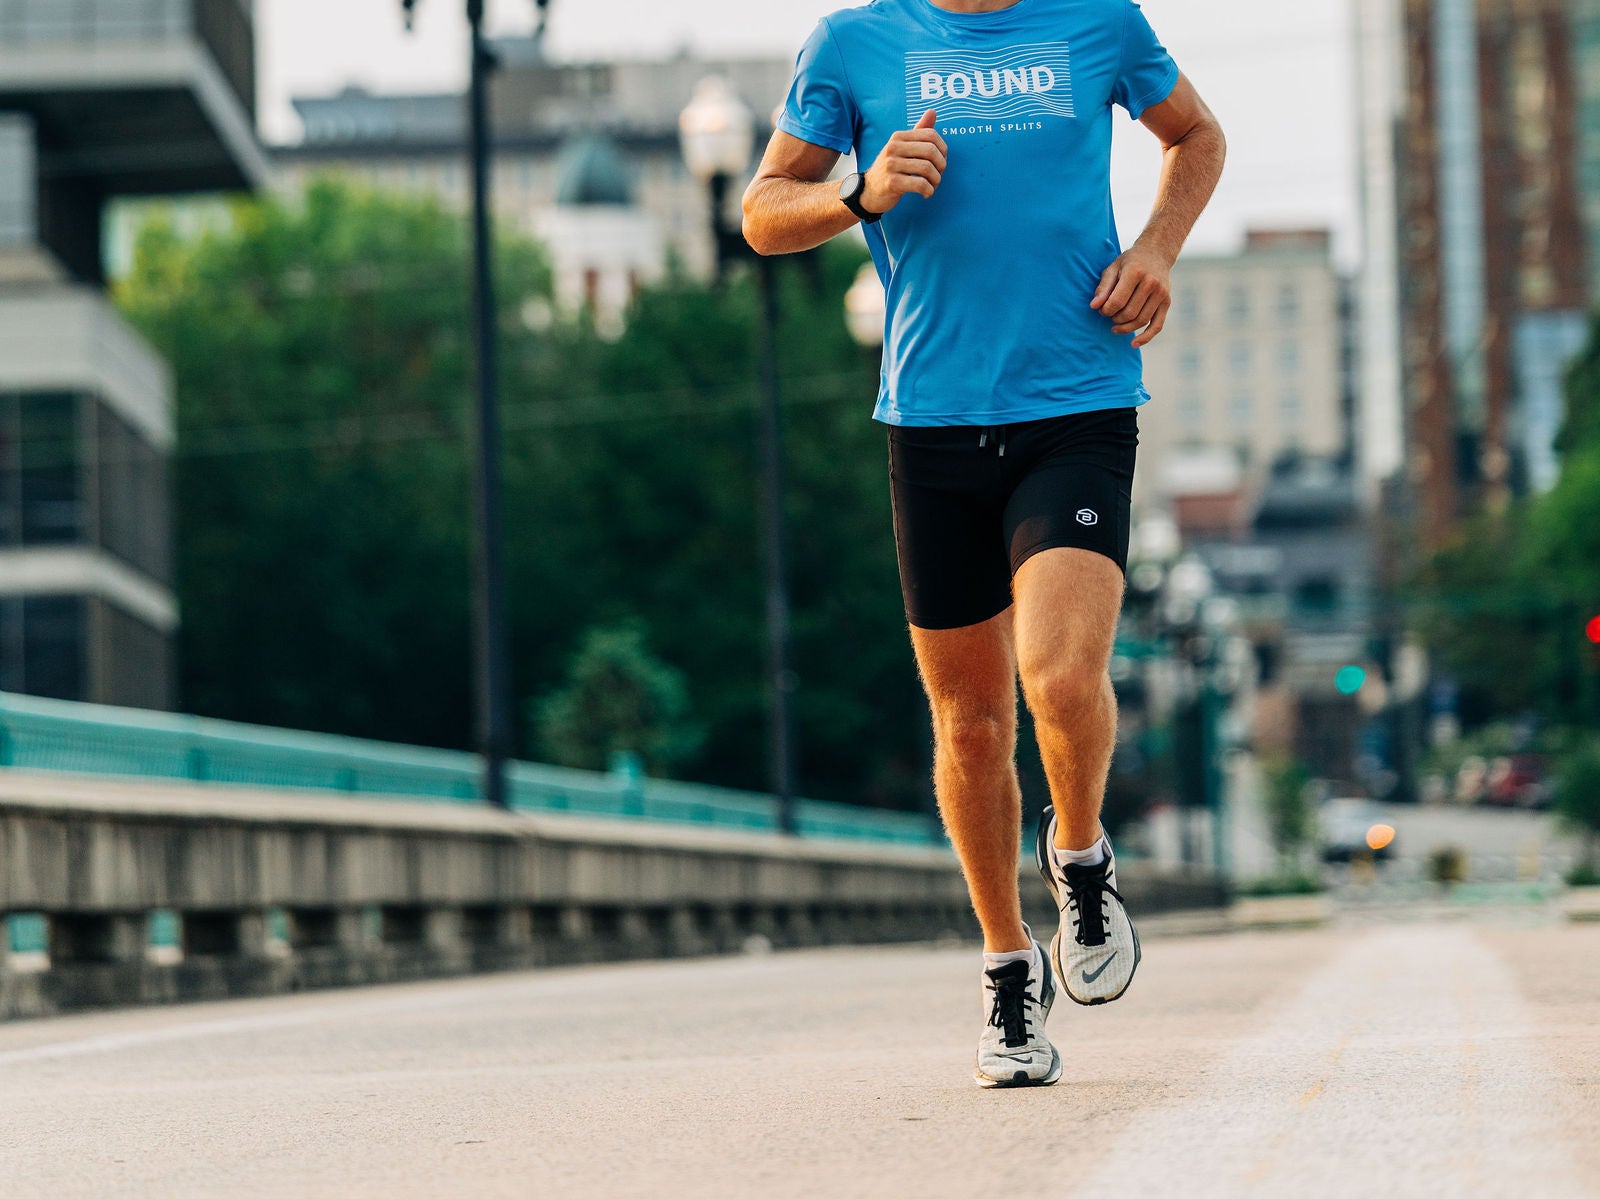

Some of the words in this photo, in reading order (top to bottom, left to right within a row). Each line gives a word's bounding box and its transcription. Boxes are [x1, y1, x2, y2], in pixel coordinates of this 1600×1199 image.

[920, 66, 1055, 100] BOUND
[942, 125, 993, 135] SMOOTH
[1000, 121, 1042, 132] SPLITS
